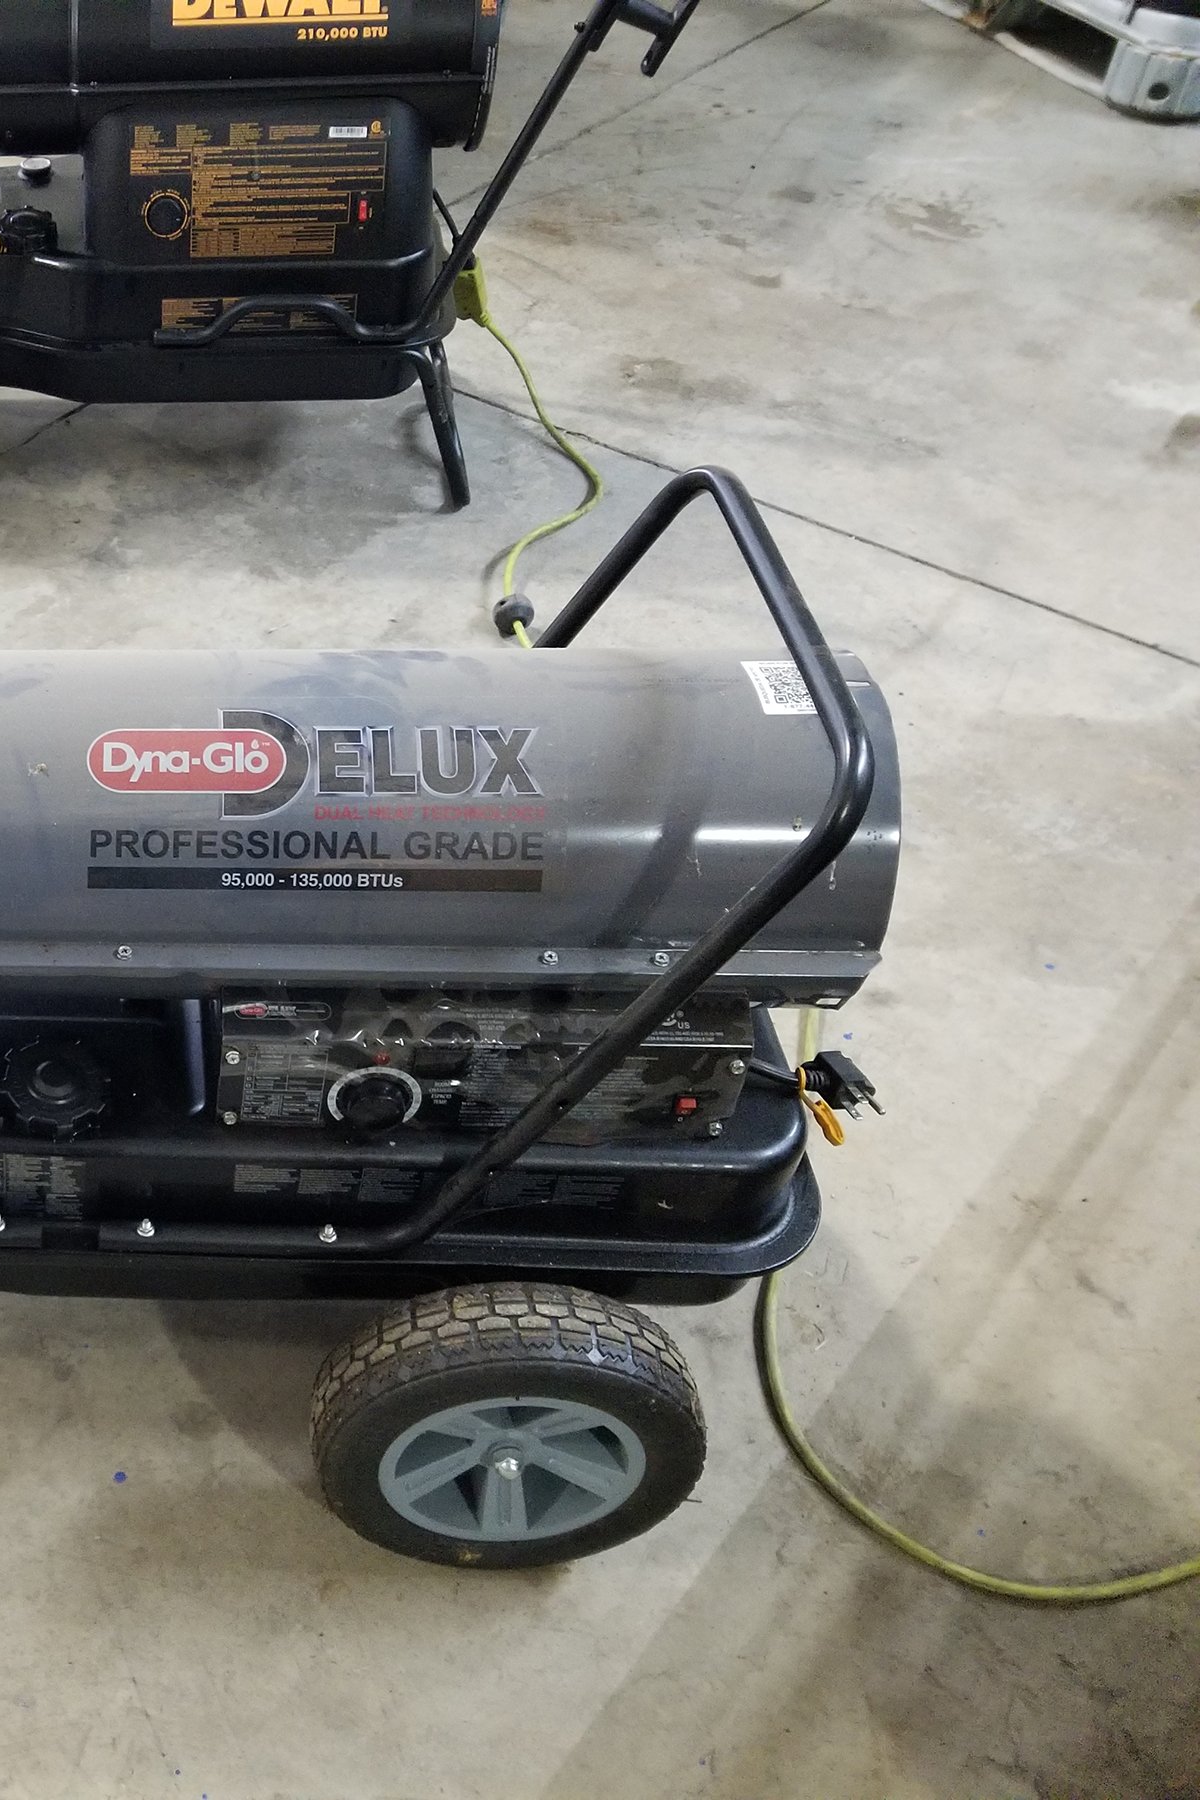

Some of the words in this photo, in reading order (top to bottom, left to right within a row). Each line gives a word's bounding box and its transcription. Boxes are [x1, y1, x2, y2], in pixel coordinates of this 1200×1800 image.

[297, 26, 357, 41] 210,000
[362, 25, 388, 39] BTU
[314, 805, 363, 820] DUAL
[90, 829, 391, 860] PROFESSIONAL
[403, 830, 544, 862] GRADE
[221, 872, 275, 889] 95,000
[290, 872, 352, 890] 135,000
[357, 872, 404, 889] BTUs
